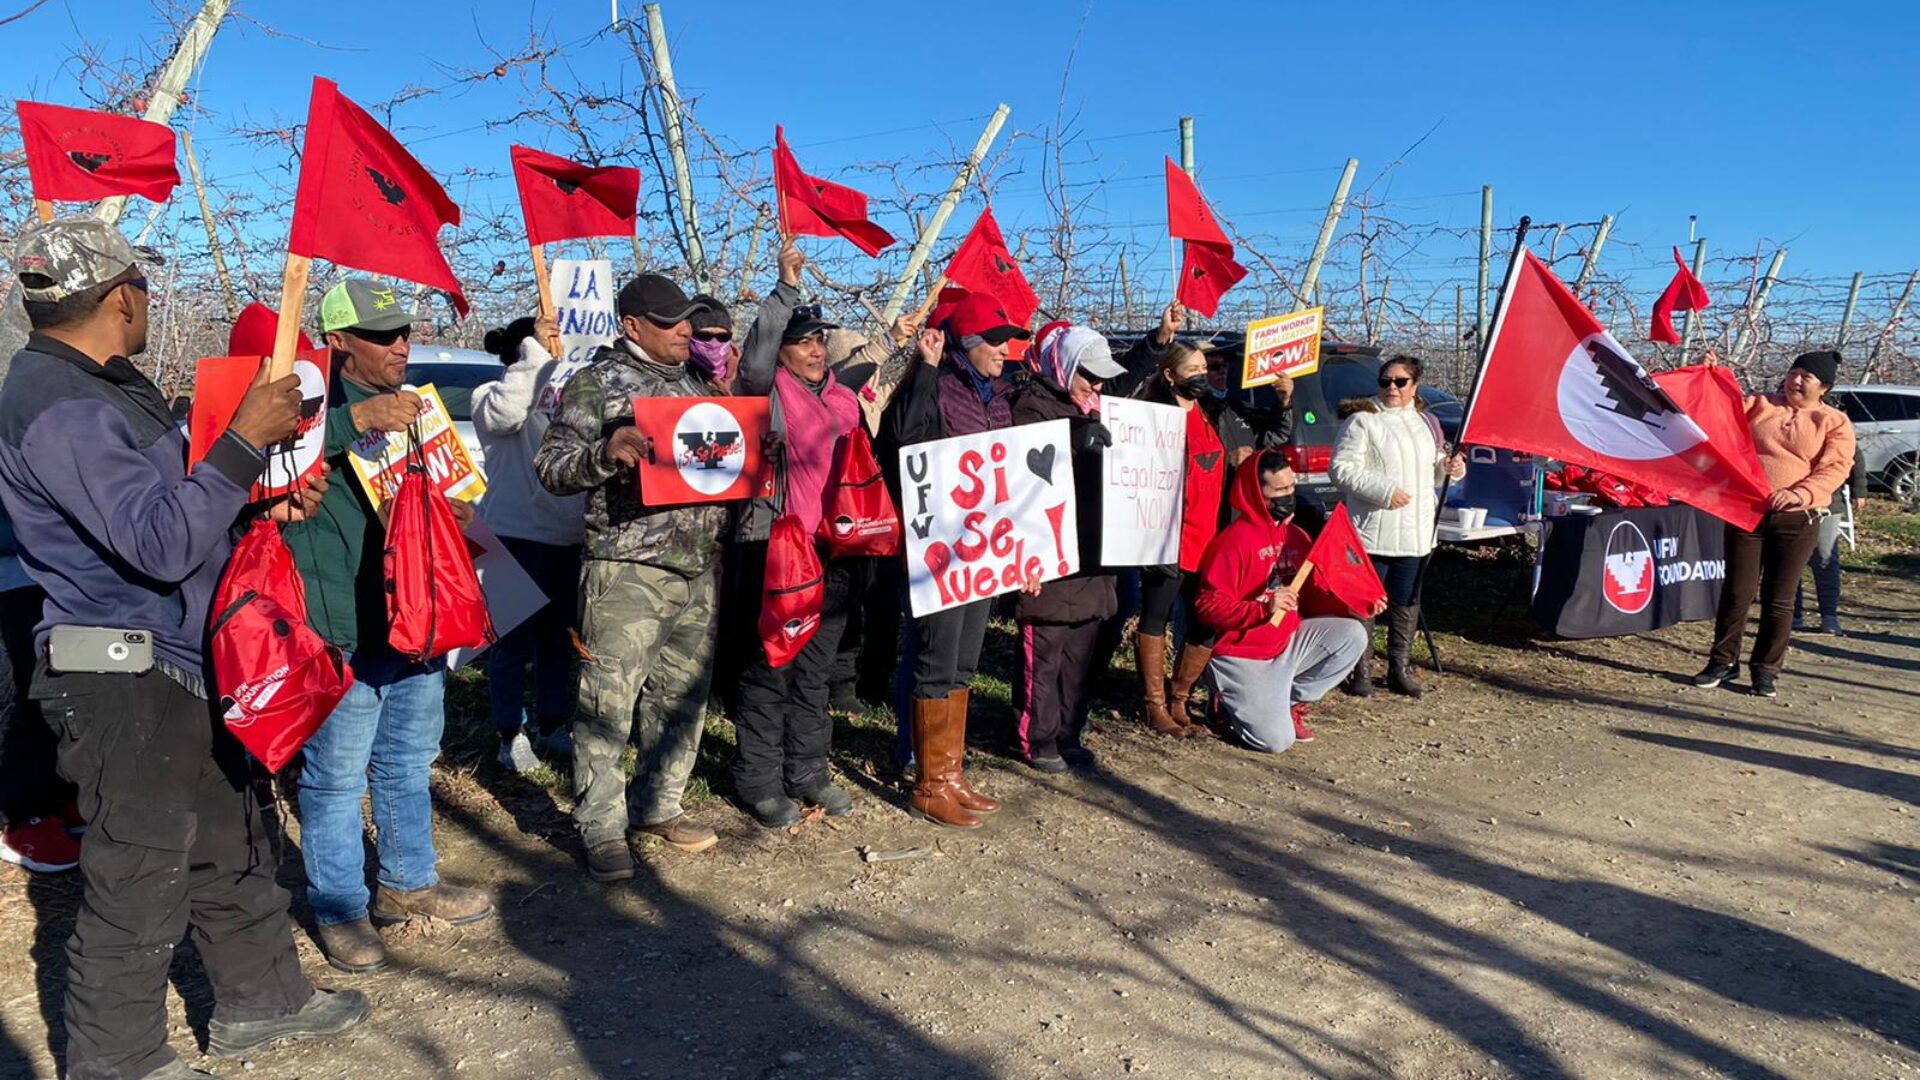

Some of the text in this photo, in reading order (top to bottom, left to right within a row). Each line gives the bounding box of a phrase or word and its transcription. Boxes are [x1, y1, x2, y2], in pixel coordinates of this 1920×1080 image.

[568, 266, 600, 299] LA
[1255, 315, 1316, 341] FARM WORKER
[1108, 402, 1146, 446] Farm
[950, 442, 1011, 510] Si
[952, 511, 1015, 563] Se
[1653, 537, 1679, 560] UFW
